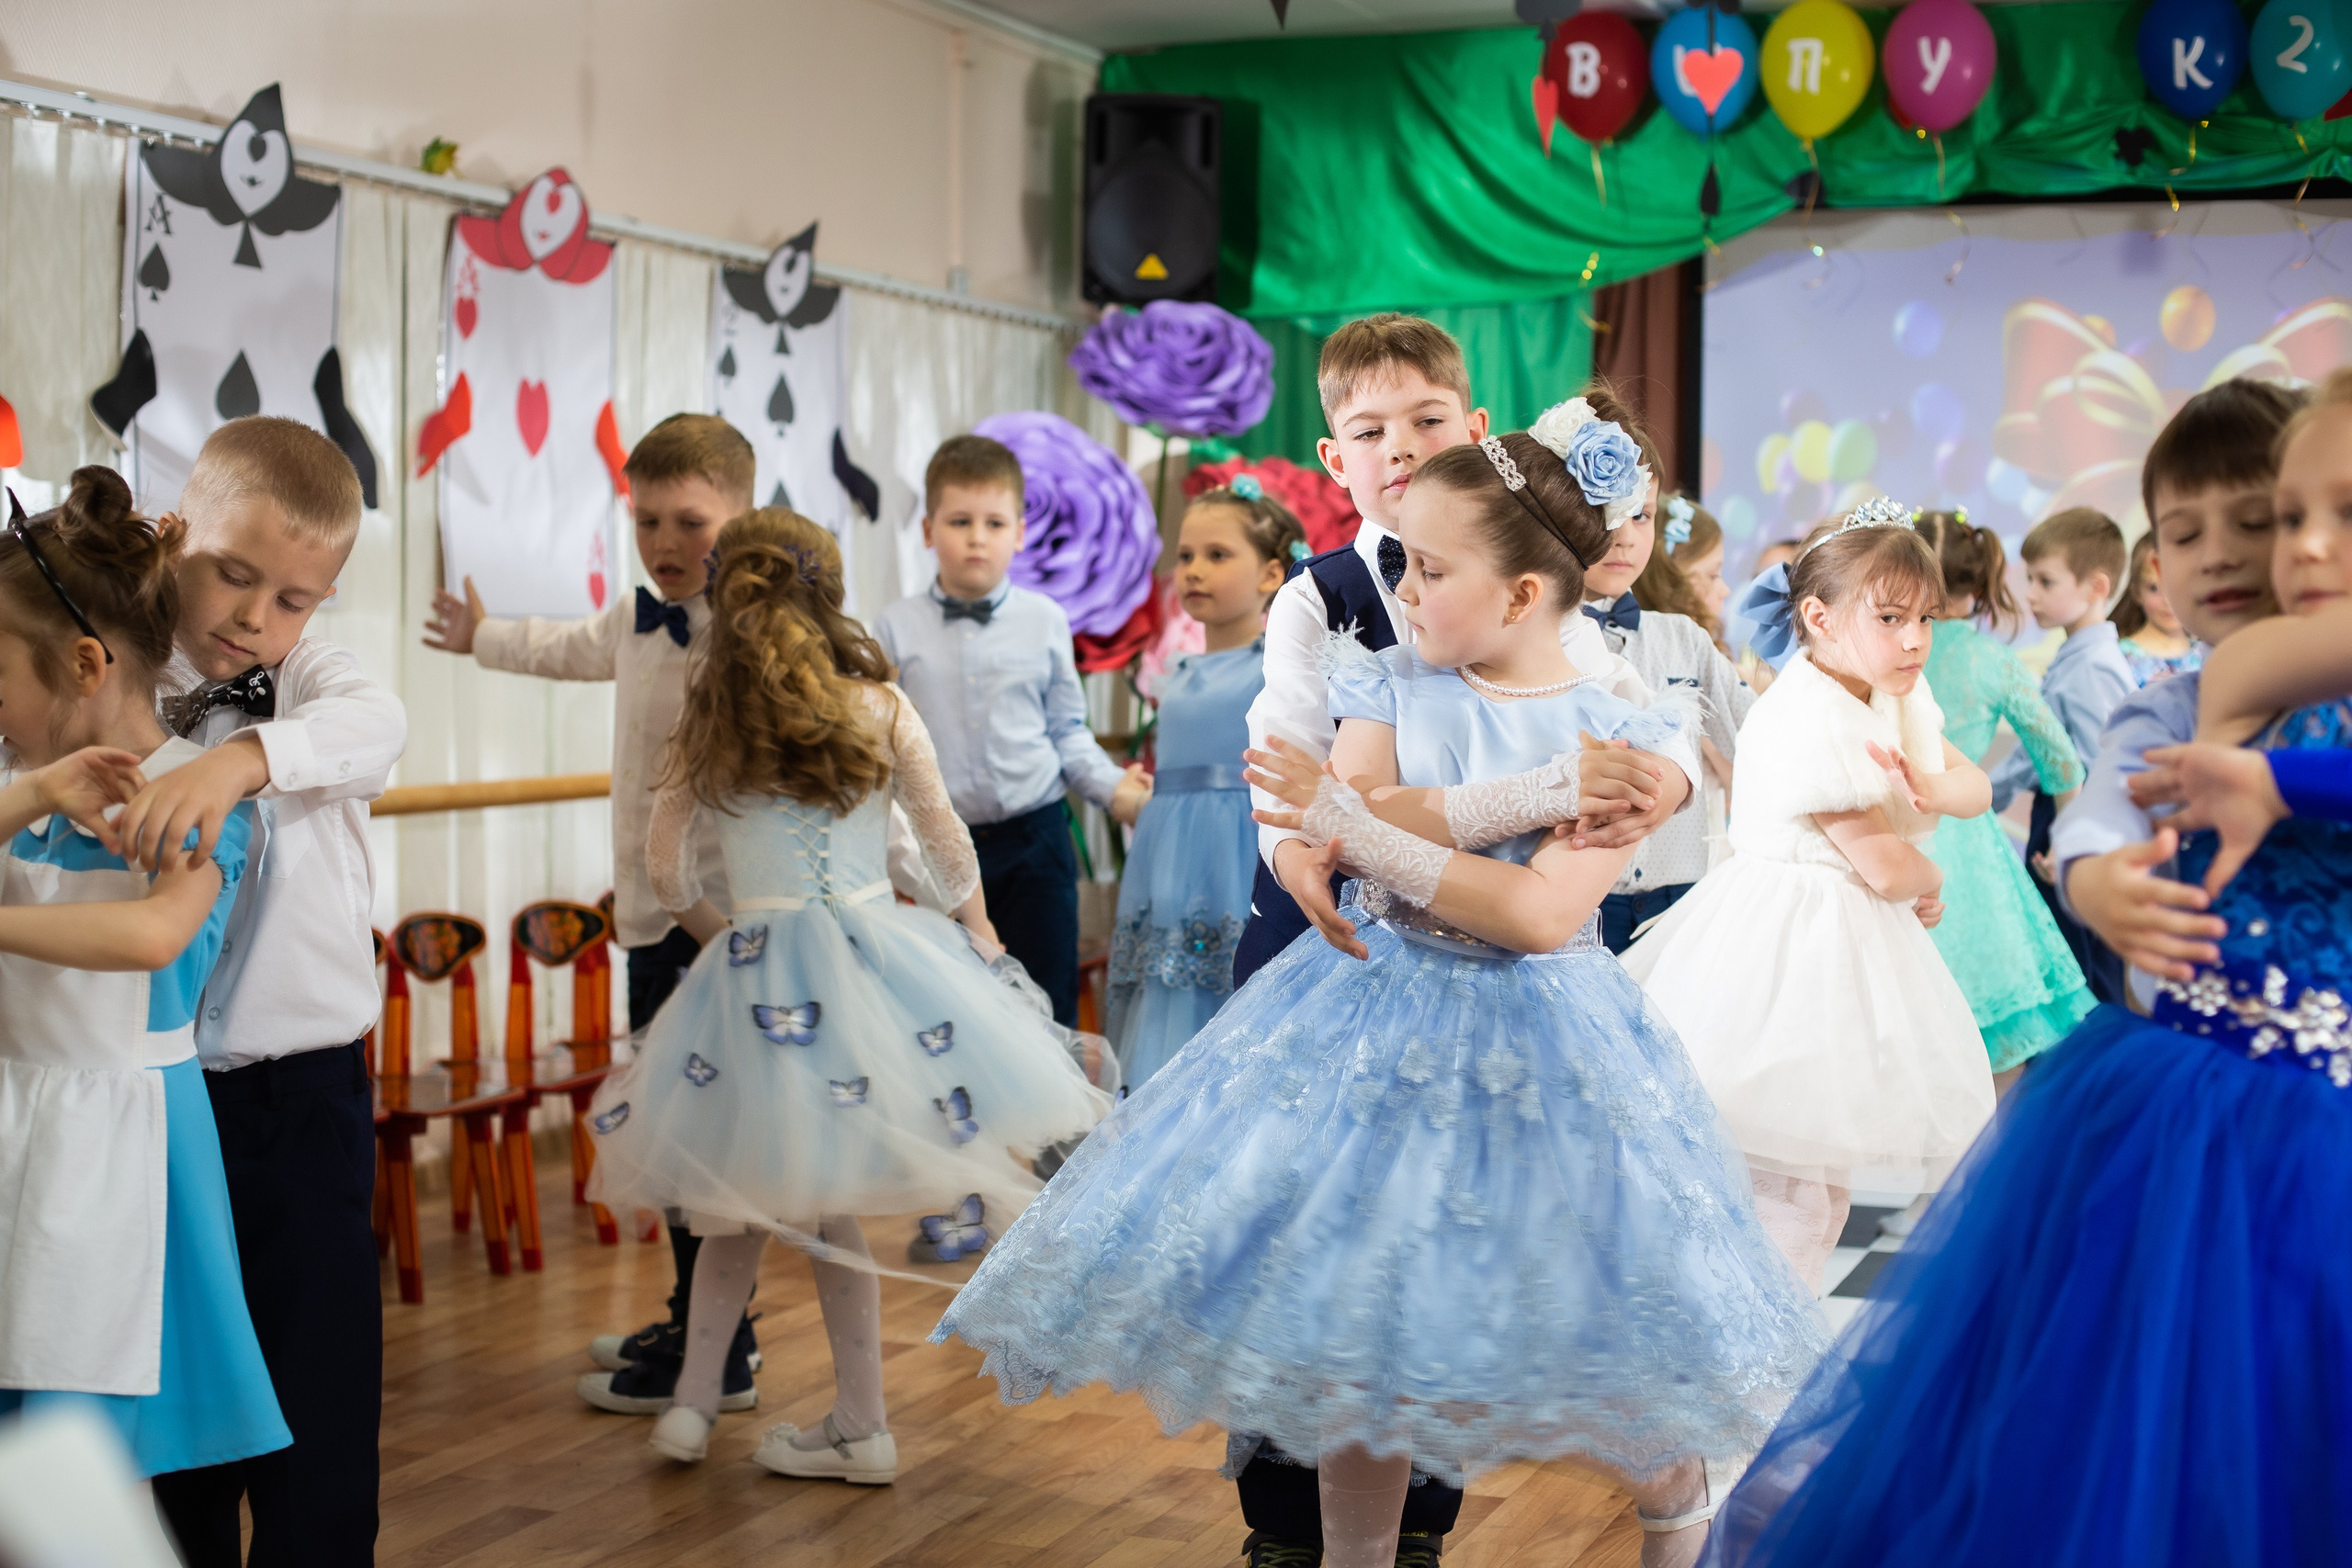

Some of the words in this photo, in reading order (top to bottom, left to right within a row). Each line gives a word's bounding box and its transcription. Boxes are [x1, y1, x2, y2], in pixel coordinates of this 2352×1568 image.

[1787, 37, 1824, 96] П
[2276, 15, 2314, 73] 2
[144, 192, 175, 236] A
